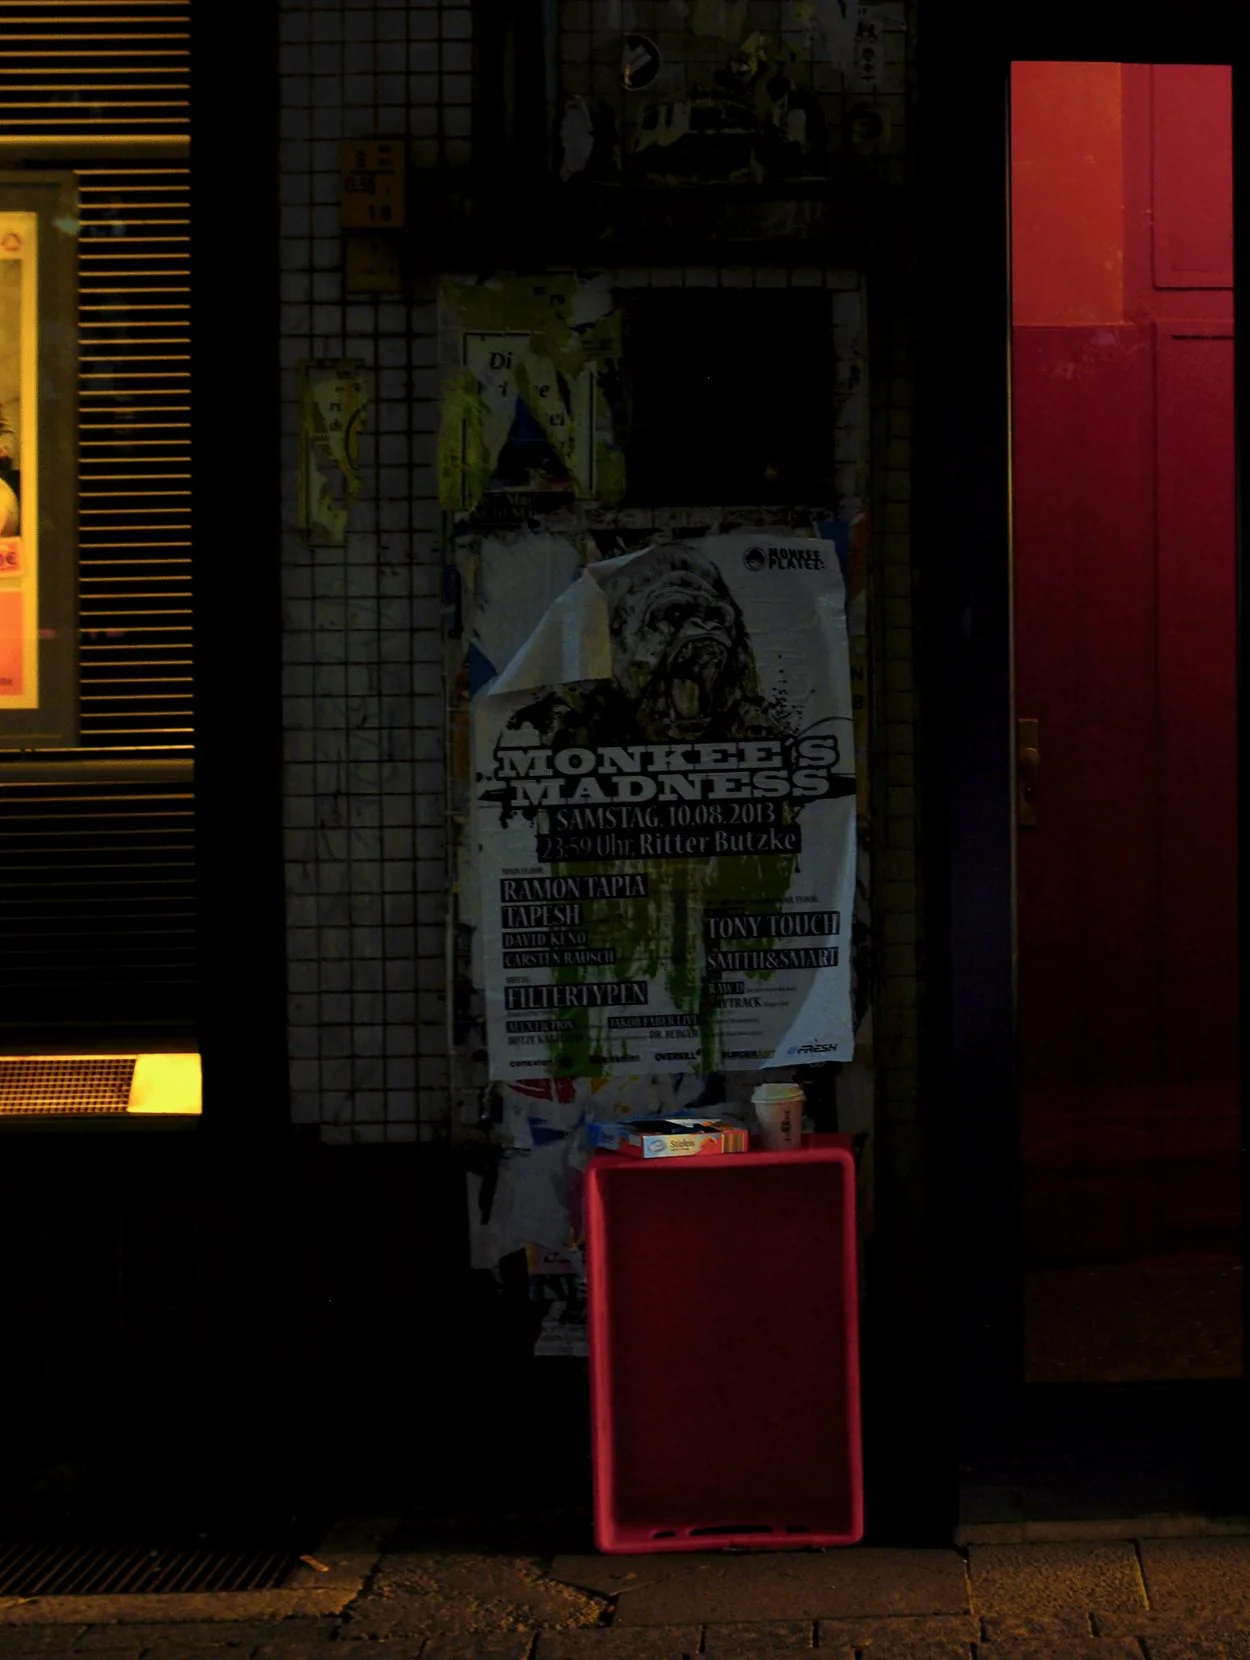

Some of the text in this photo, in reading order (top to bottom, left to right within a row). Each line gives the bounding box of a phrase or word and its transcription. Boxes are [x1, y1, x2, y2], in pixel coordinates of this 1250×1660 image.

[768, 547, 821, 561] MONKEE
[510, 769, 831, 808] MADNESS
[668, 802, 776, 827] 10.08.2013
[542, 835, 593, 860] 23:59
[639, 830, 711, 855] Ritter
[714, 827, 798, 853] Butzke
[503, 875, 646, 902] RAMON TAPIA
[503, 903, 581, 928] TAPESH
[708, 912, 838, 939] TONY TOUCH
[504, 930, 587, 948] DAVID KENO
[504, 949, 615, 967] CARSTEN RAUSCH
[707, 948, 838, 970] SMITH&SMART
[507, 982, 647, 1009] FILTERTYPEN
